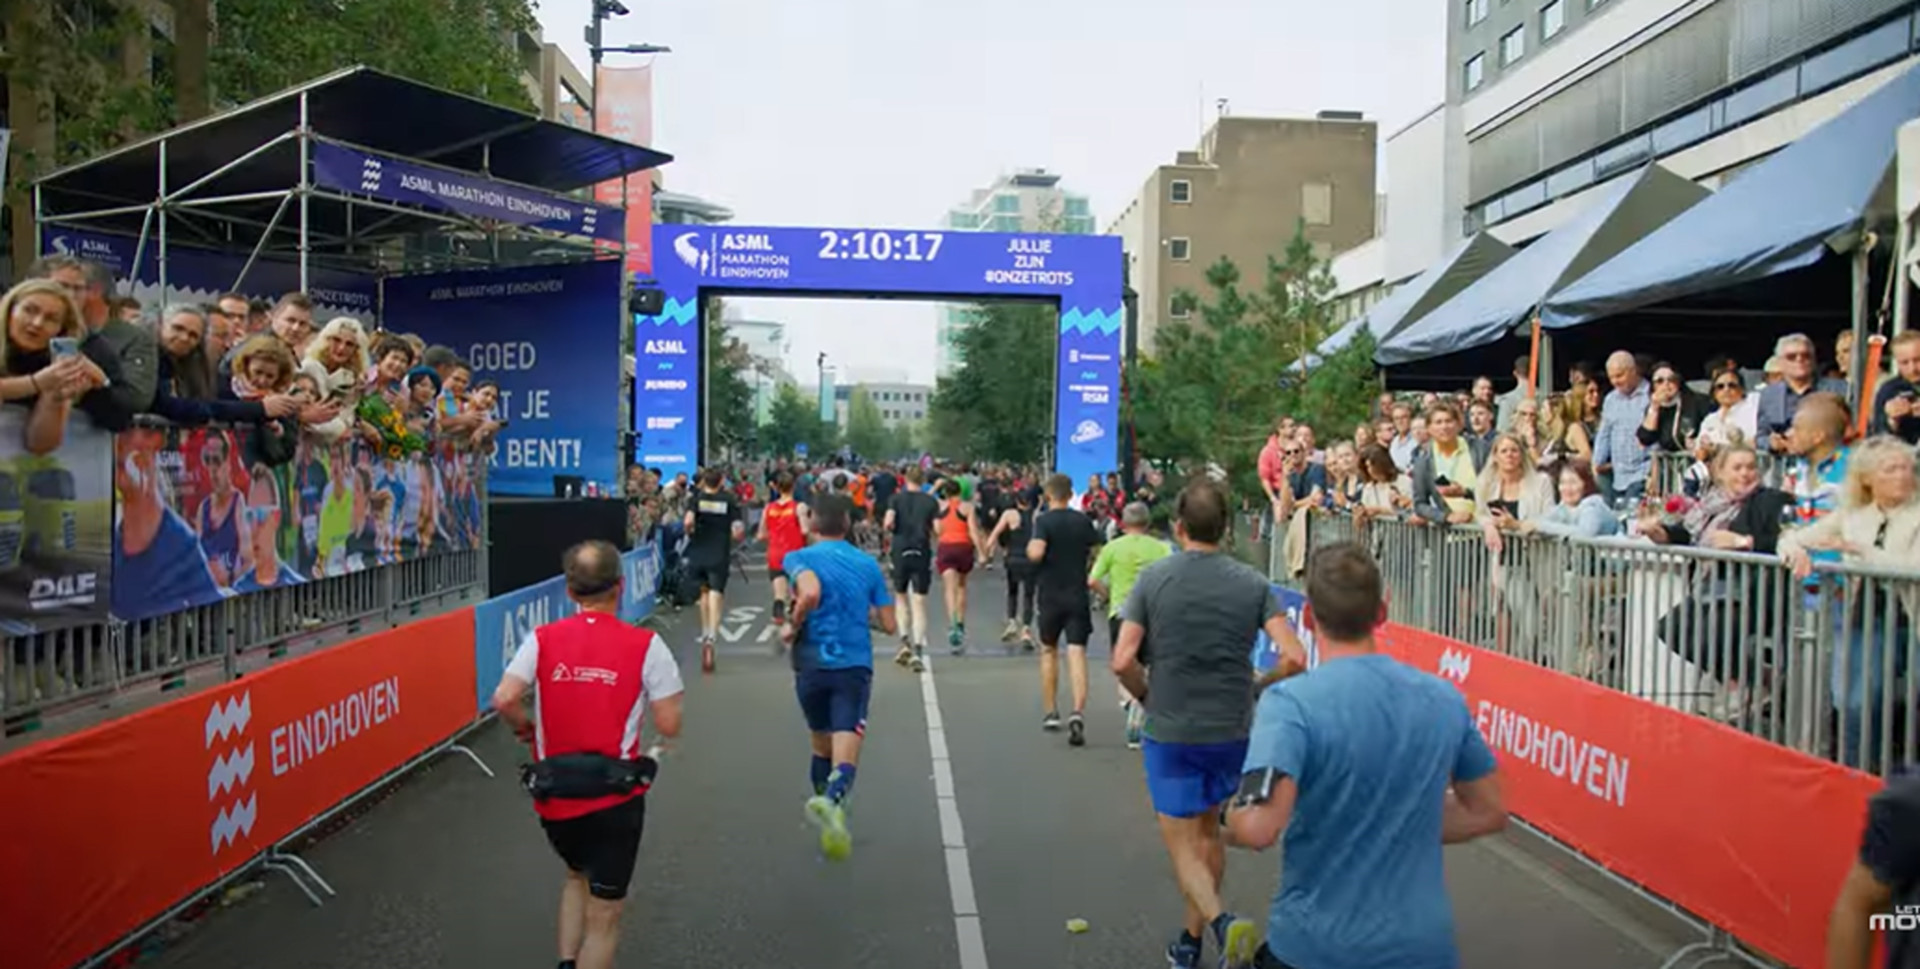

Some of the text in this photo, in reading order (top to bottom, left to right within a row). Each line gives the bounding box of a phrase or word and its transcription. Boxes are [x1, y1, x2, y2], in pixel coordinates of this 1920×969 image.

[400, 174, 572, 222] ASML MARATHON EINDHOVEN
[721, 234, 774, 251] ASML
[818, 231, 944, 261] 2:10:17
[1006, 238, 1053, 253] JULLIE
[720, 253, 790, 266] MARATHON
[720, 266, 790, 279] EINDHOVEN
[308, 286, 371, 306] ONZETROTS
[469, 342, 537, 371] GOED
[644, 339, 688, 355] ASML
[644, 379, 688, 391] JUMBO
[521, 390, 550, 419] JE
[507, 438, 583, 469] BENT!
[29, 572, 96, 600] DAF
[270, 674, 400, 777] EINDHOVEN
[1475, 699, 1630, 807] EINDHOVEN
